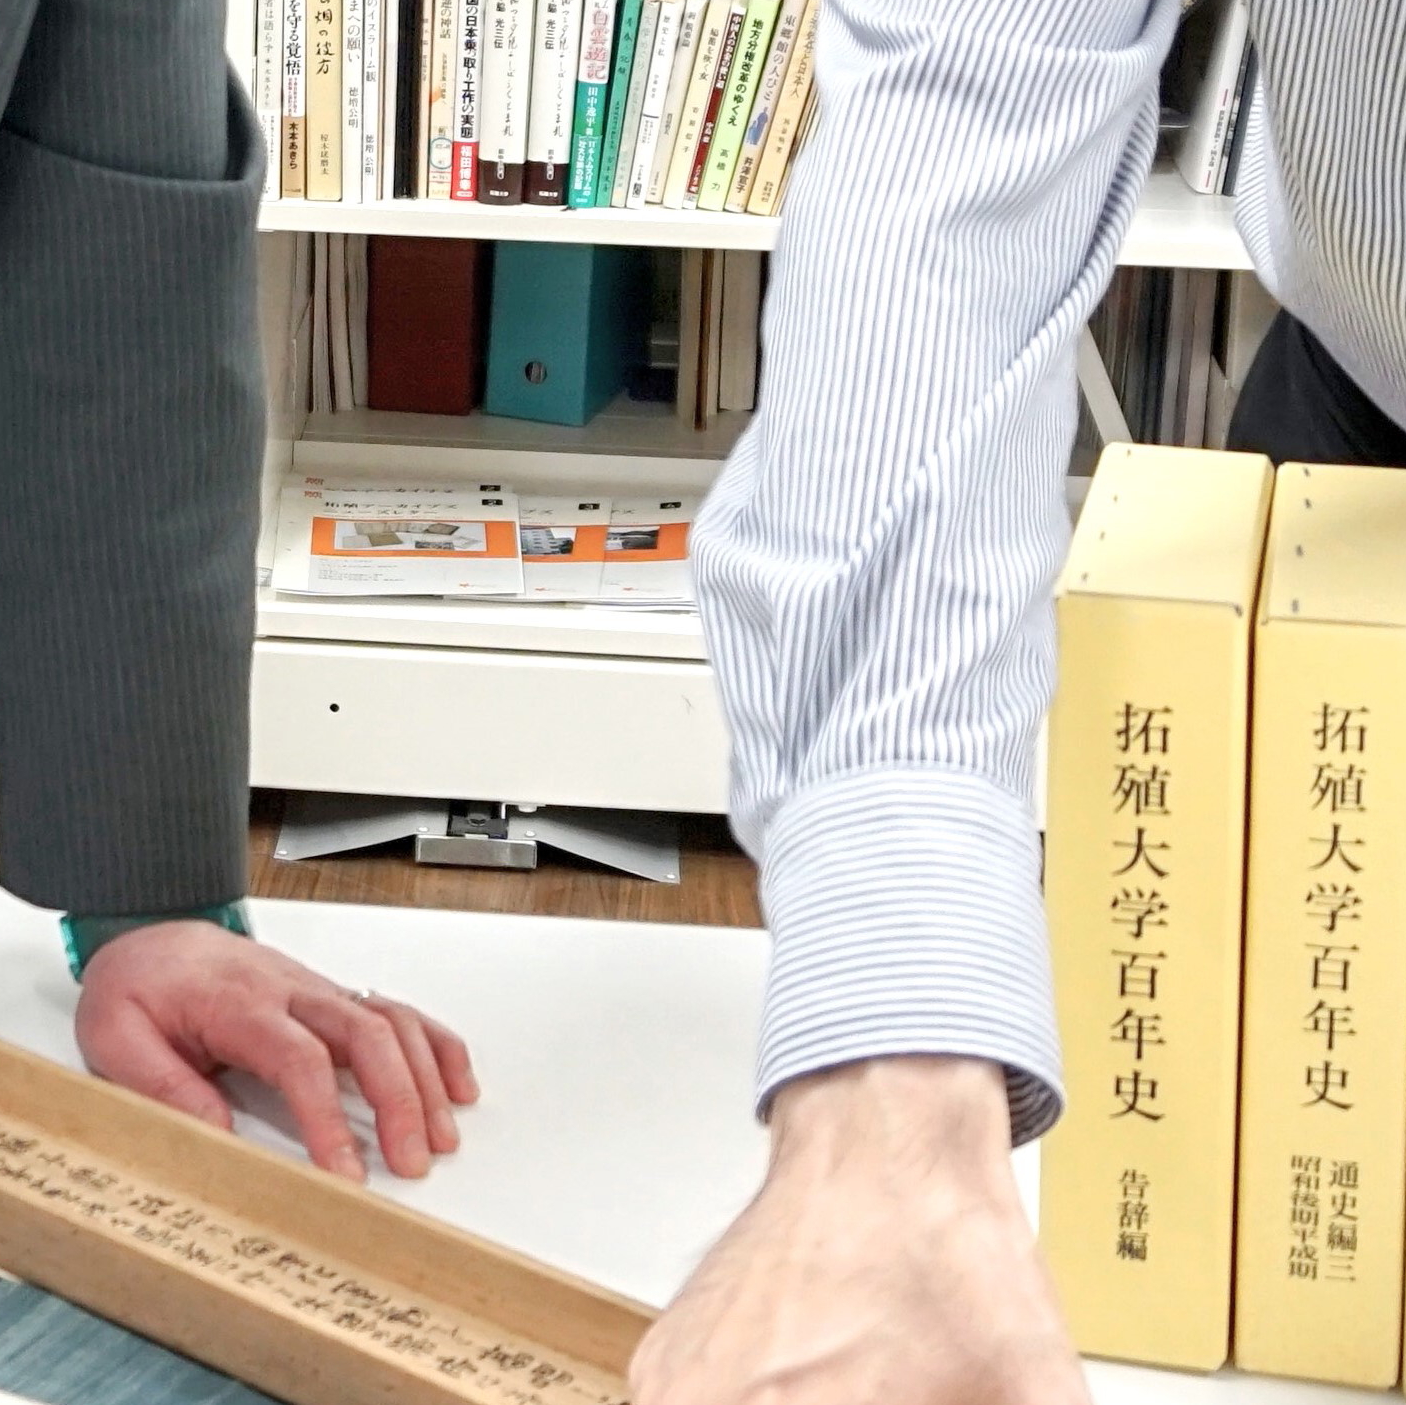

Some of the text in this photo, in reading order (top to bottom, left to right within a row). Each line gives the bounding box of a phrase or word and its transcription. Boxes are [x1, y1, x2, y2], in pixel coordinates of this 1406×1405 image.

[584, 9, 607, 81] 白雲遊記
[726, 18, 764, 127] 地方分権改革のゆくえ
[1109, 701, 1175, 1123] 拓殖大学百年史
[1302, 702, 1370, 1112] 拓殖大学百年史
[1115, 1167, 1151, 1262] 告辞編
[1286, 1153, 1322, 1281] 昭和後期平成期
[1326, 1159, 1361, 1285] 通史編三
